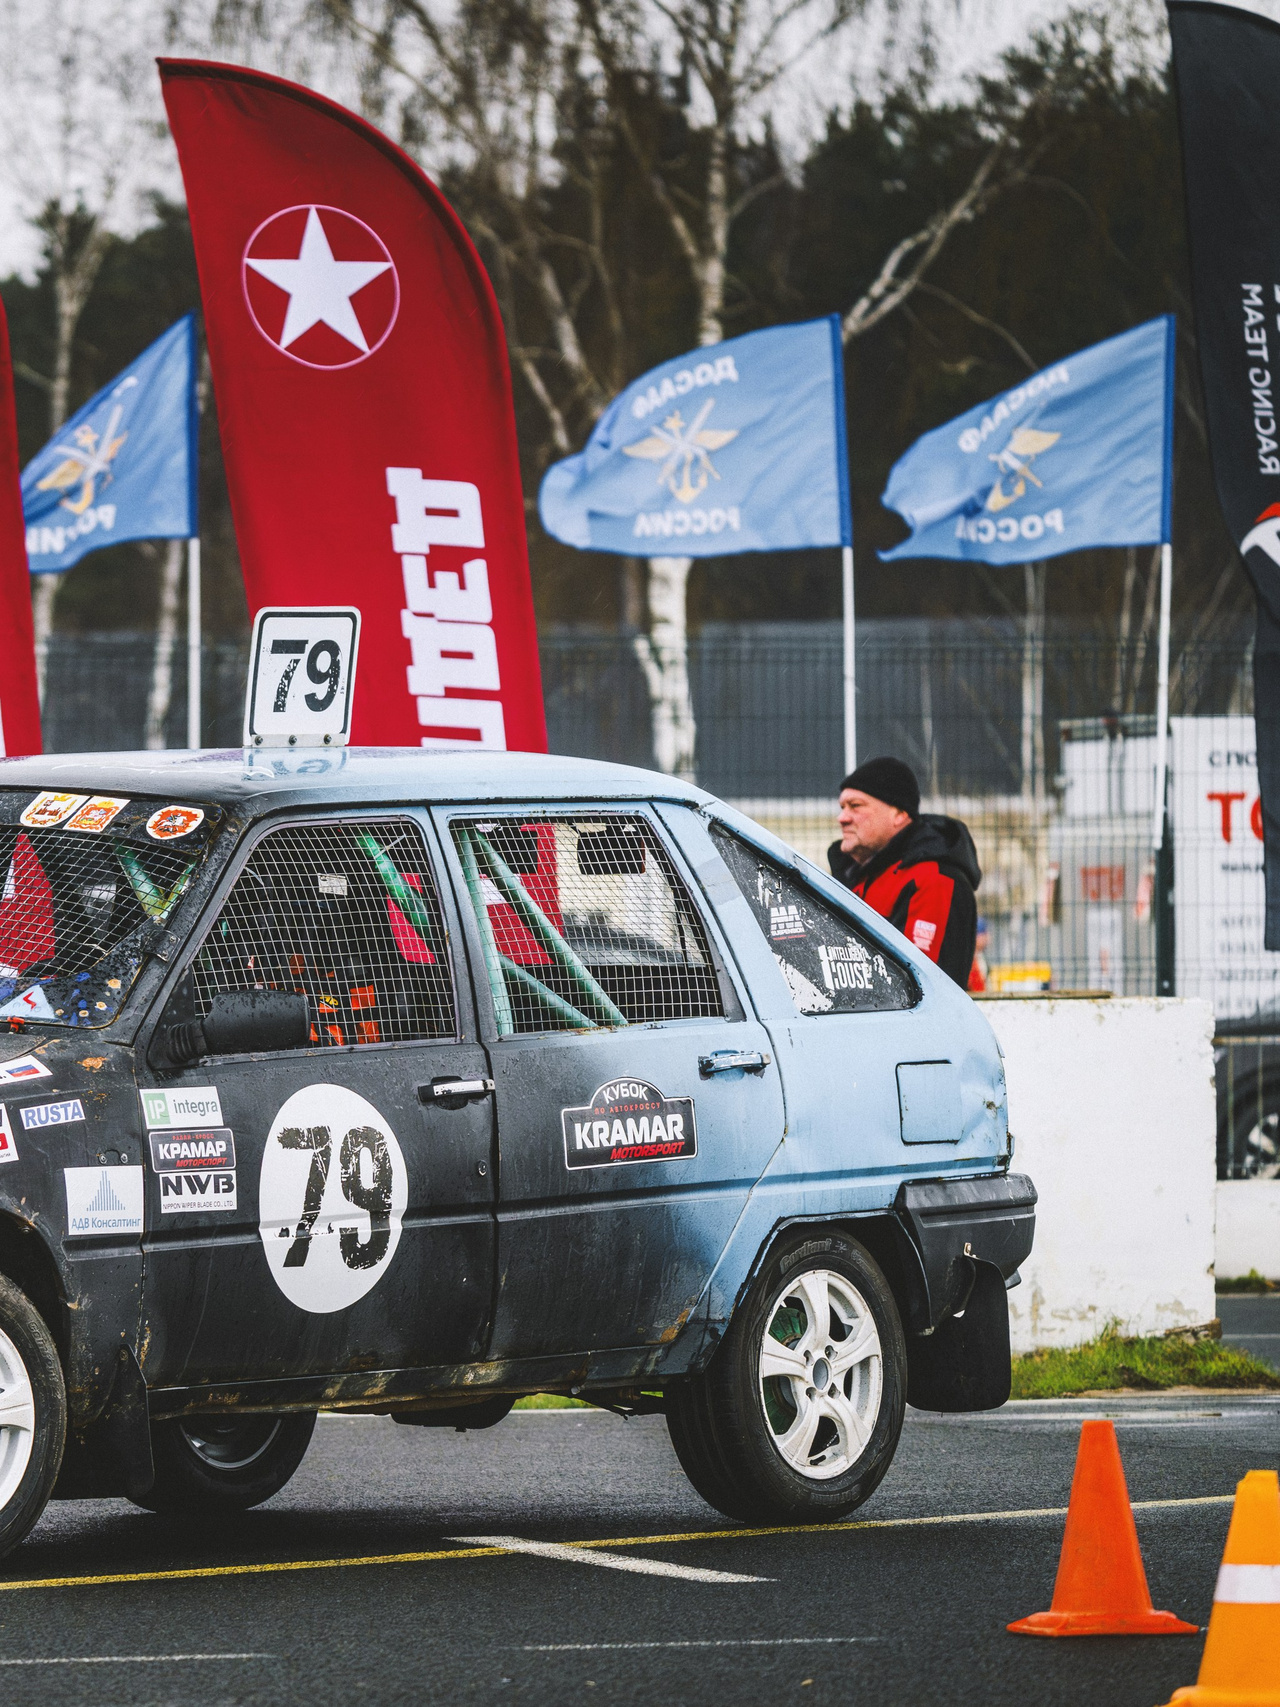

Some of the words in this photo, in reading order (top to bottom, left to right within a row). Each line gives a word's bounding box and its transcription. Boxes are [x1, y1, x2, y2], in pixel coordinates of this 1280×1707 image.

[270, 639, 342, 713] 79
[602, 1082, 649, 1104] КУБОК
[24, 1101, 83, 1128] RUSTA
[148, 1099, 166, 1120] IP
[173, 1099, 219, 1117] integra
[594, 1107, 606, 1115] ПО
[609, 1102, 661, 1114] АВТОКРОССУ
[574, 1113, 686, 1150] KRAMAR
[158, 1140, 227, 1160] КРАМАР
[610, 1141, 686, 1160] MOTORSPORT
[176, 1157, 228, 1168] МОТОРСПОРТ
[161, 1173, 235, 1197] NWB
[163, 1202, 181, 1210] NIPPON
[182, 1201, 197, 1209] WIPER
[276, 1124, 393, 1271] 79
[71, 1217, 90, 1230] АДВ
[91, 1217, 141, 1229] Консалтинг
